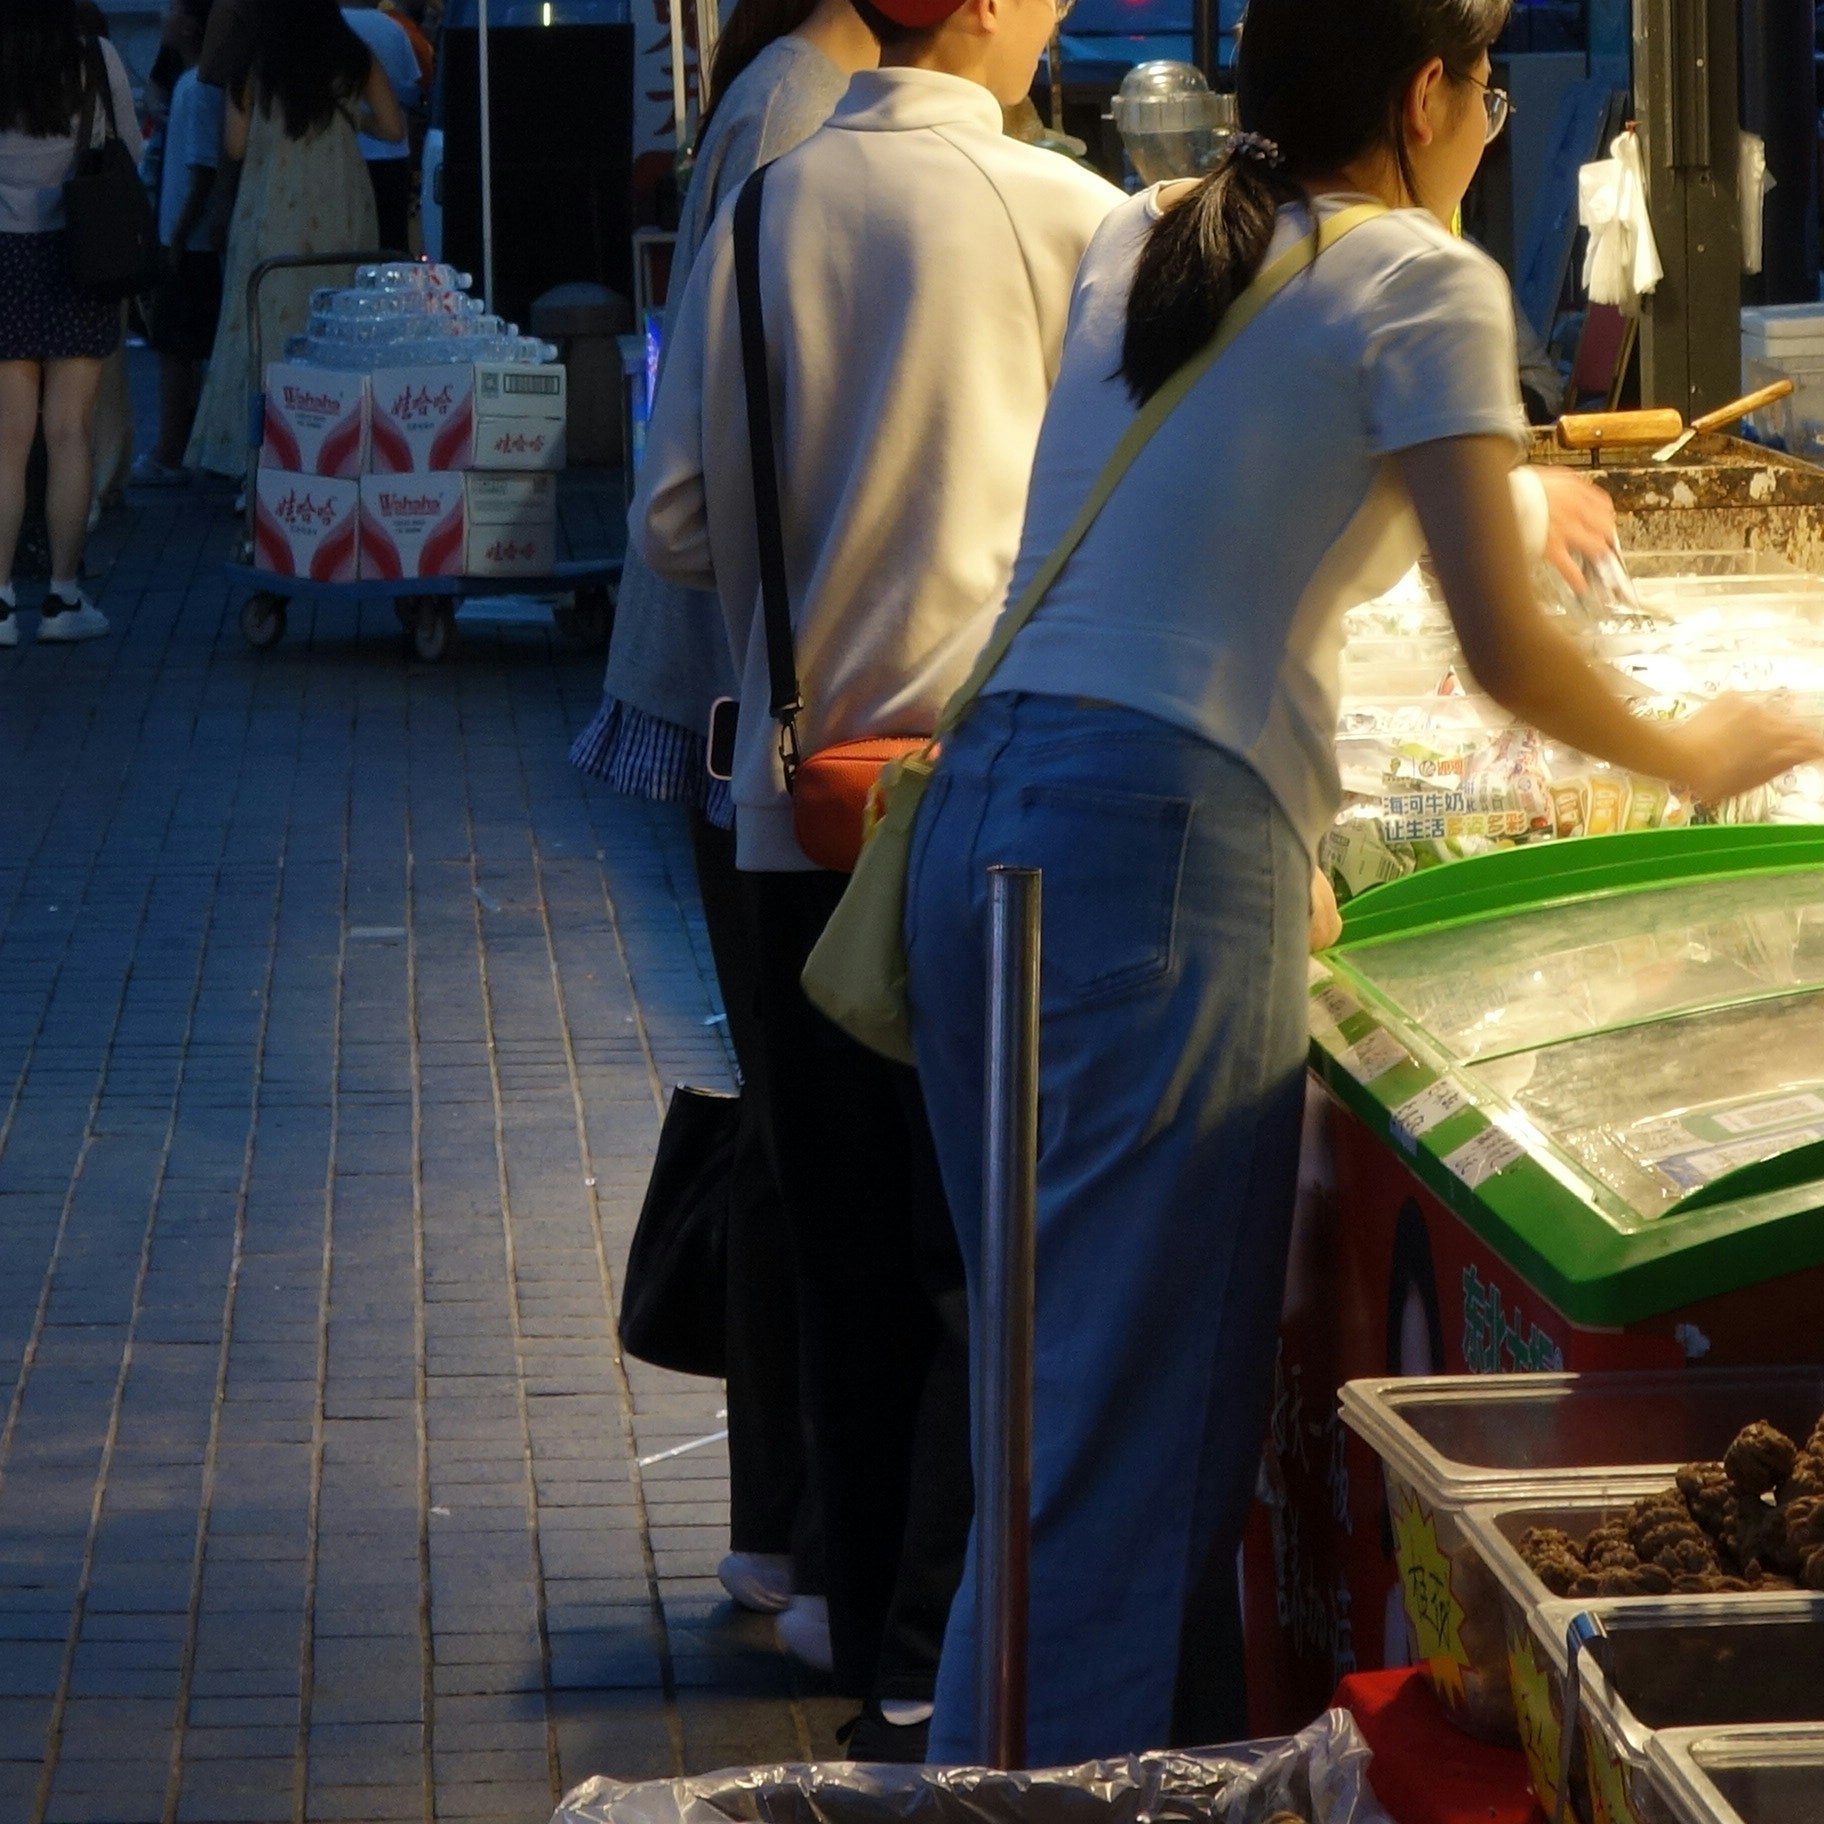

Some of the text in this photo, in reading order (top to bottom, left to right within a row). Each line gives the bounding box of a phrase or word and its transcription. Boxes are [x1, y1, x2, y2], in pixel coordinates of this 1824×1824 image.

[283, 385, 341, 412] Wahaha
[390, 384, 452, 420] 娃哈哈
[279, 488, 337, 525] 娃哈哈
[379, 492, 441, 515] Wahaha
[1382, 793, 1466, 816] 海河牛奶
[1384, 810, 1527, 843] 让生活多姿多彩
